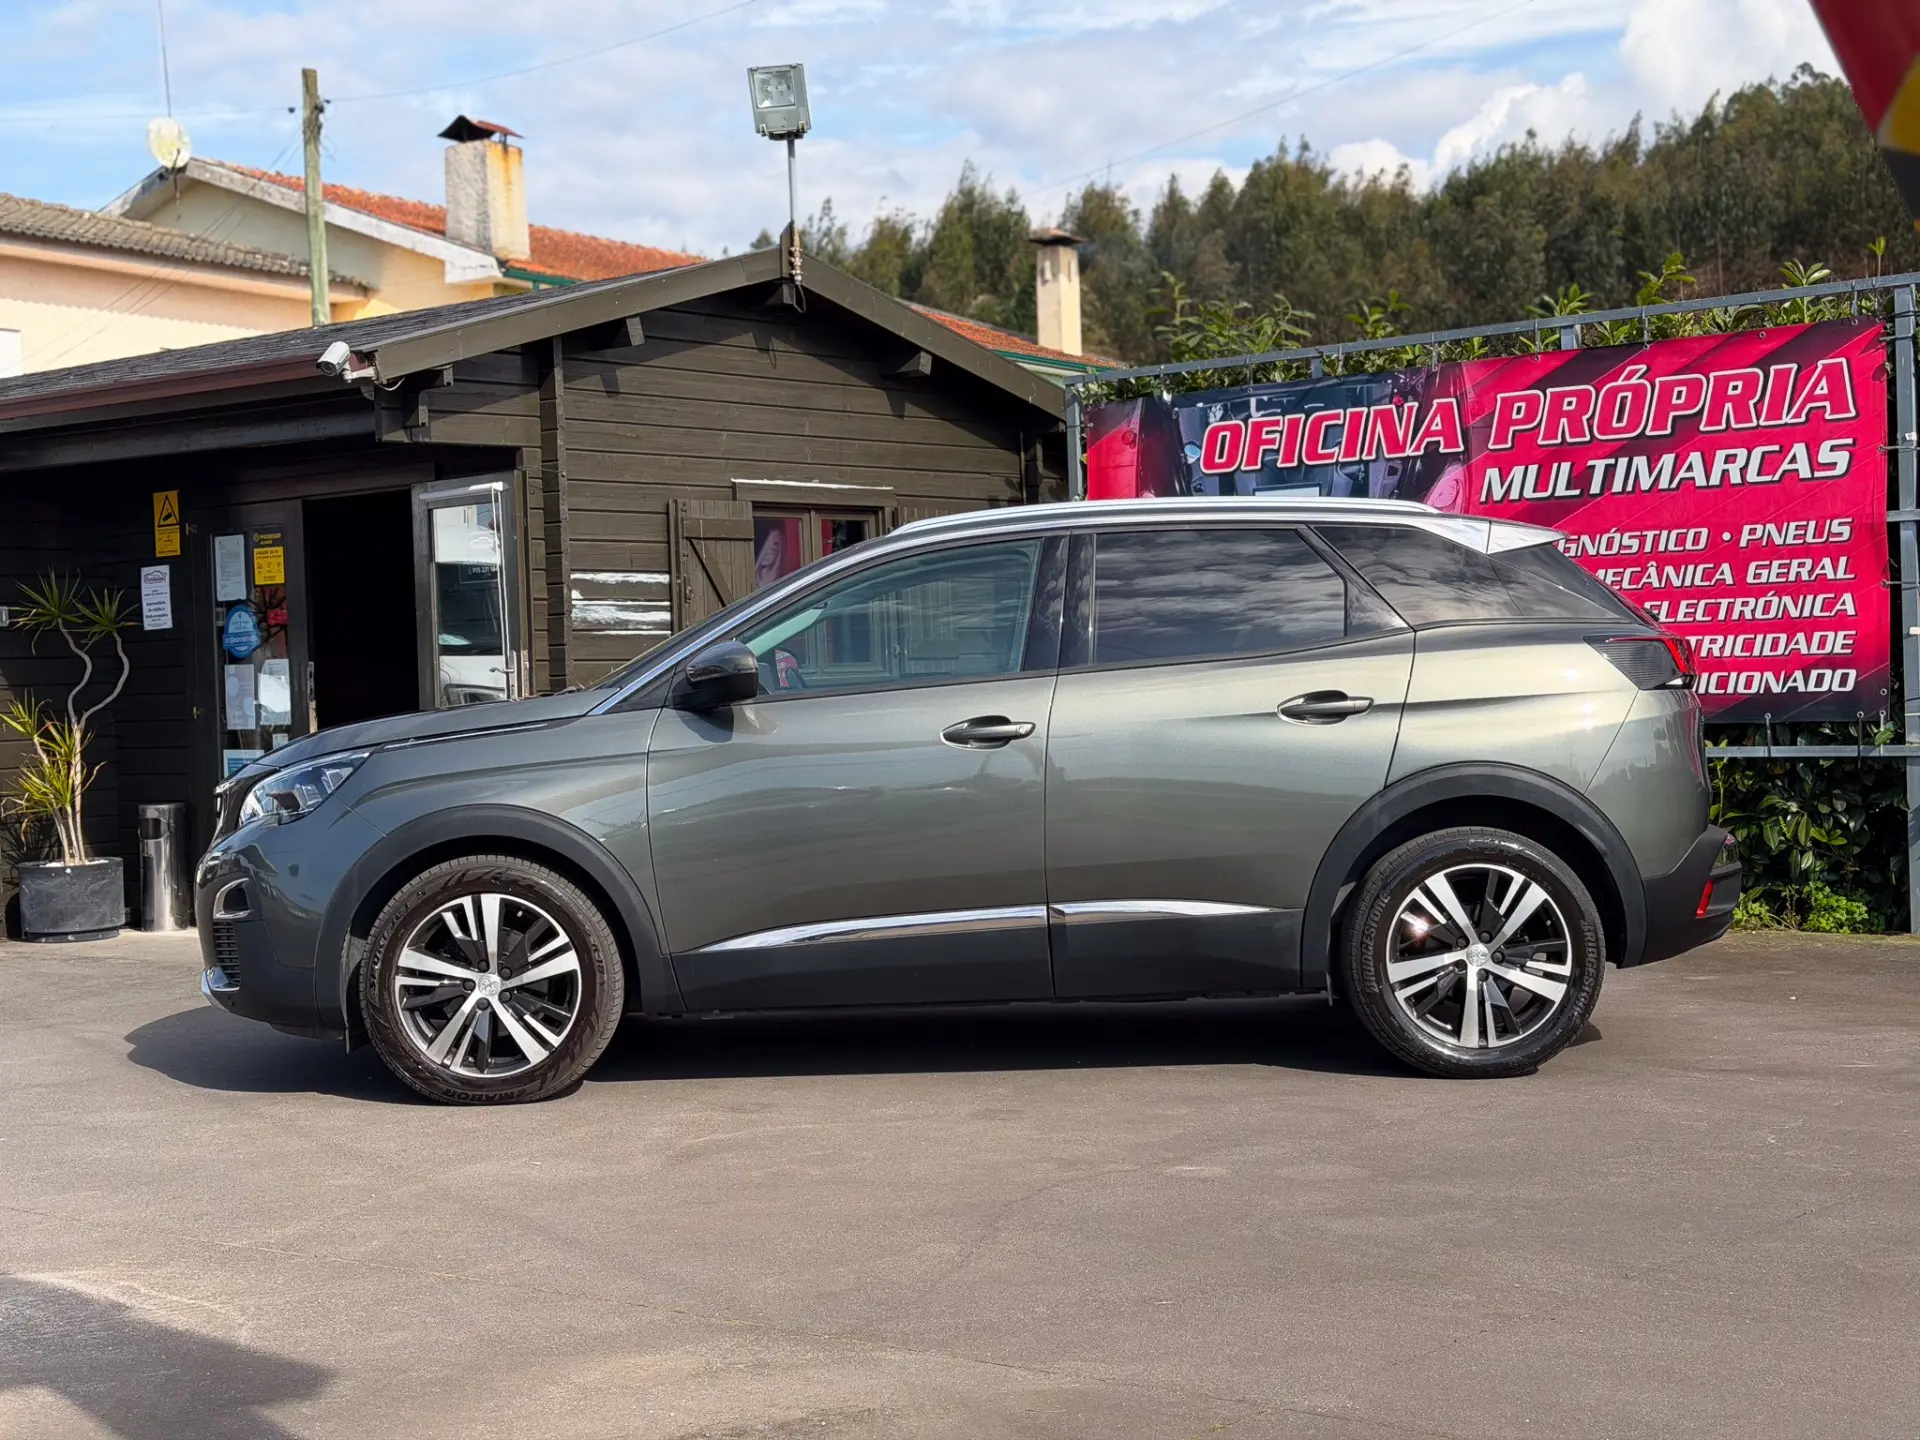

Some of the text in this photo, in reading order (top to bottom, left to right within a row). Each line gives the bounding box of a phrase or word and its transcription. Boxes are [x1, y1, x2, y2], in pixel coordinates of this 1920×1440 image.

[1200, 357, 1856, 474] OFICINA PRÓPRIA
[1480, 438, 1853, 502] MULTIMARCAS
[1739, 518, 1853, 548] PNEUS
[1746, 556, 1857, 584] GERAL
[1692, 669, 1857, 694] ICIONADO
[1361, 892, 1391, 994] BRIDGESTONE
